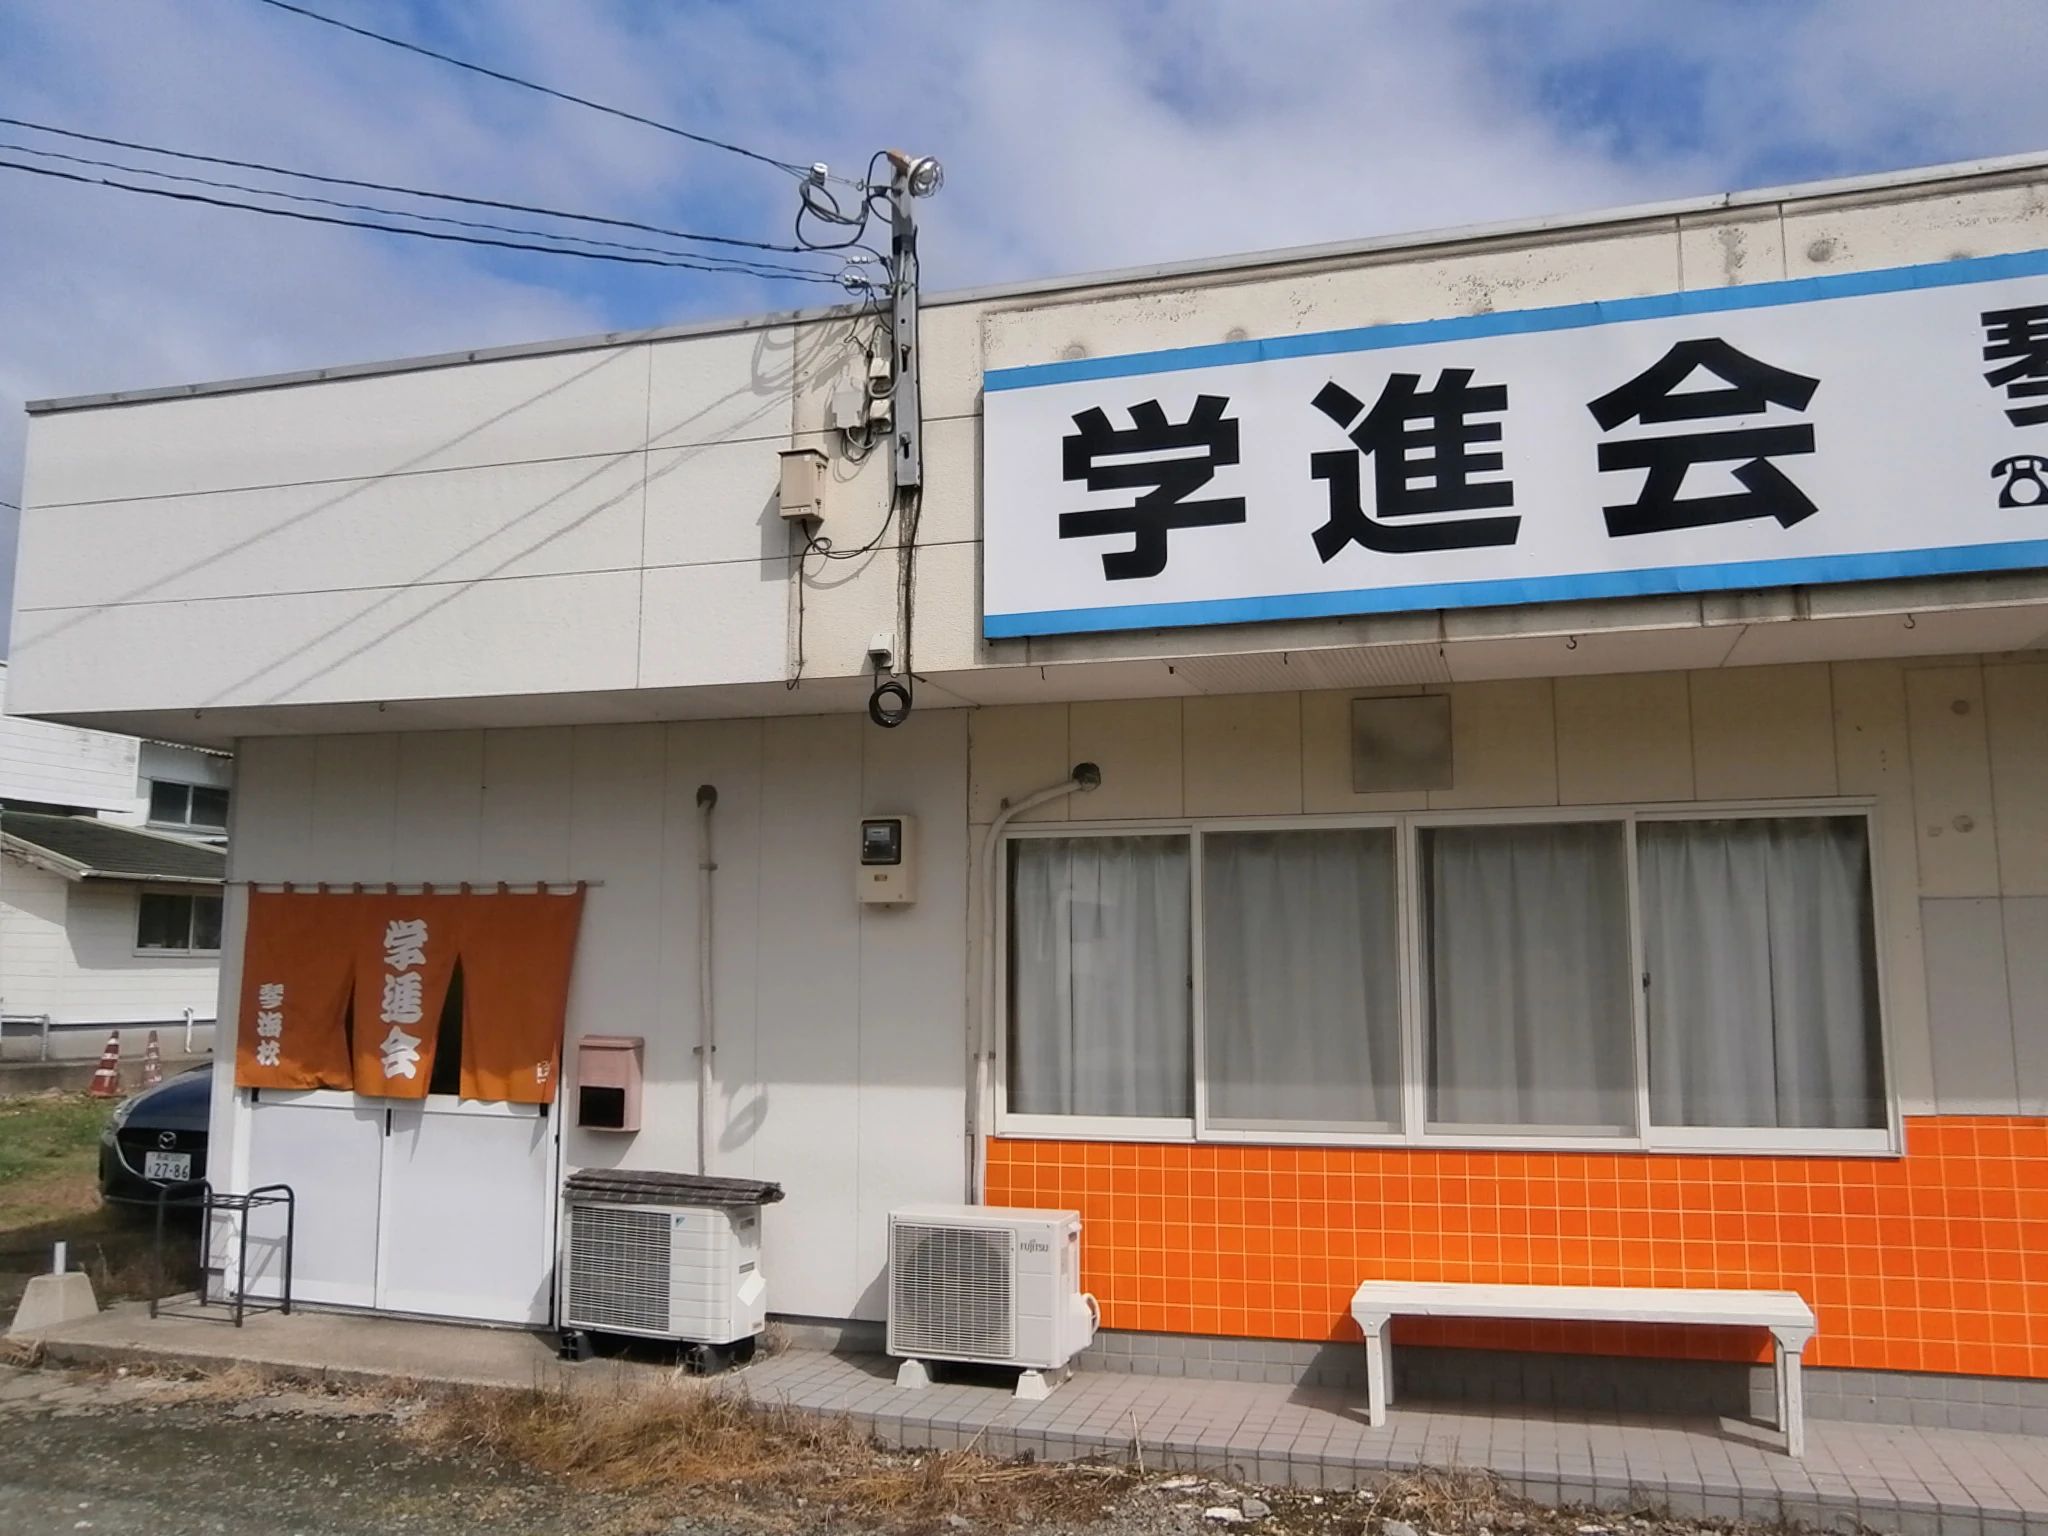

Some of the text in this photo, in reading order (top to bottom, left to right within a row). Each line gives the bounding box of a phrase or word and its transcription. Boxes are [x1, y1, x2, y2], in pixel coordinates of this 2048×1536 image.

[1058, 336, 1821, 581] 学進会
[379, 918, 428, 1079] 学進会
[154, 1162, 189, 1179] 27-86
[1020, 1238, 1049, 1253] FUJITSU
